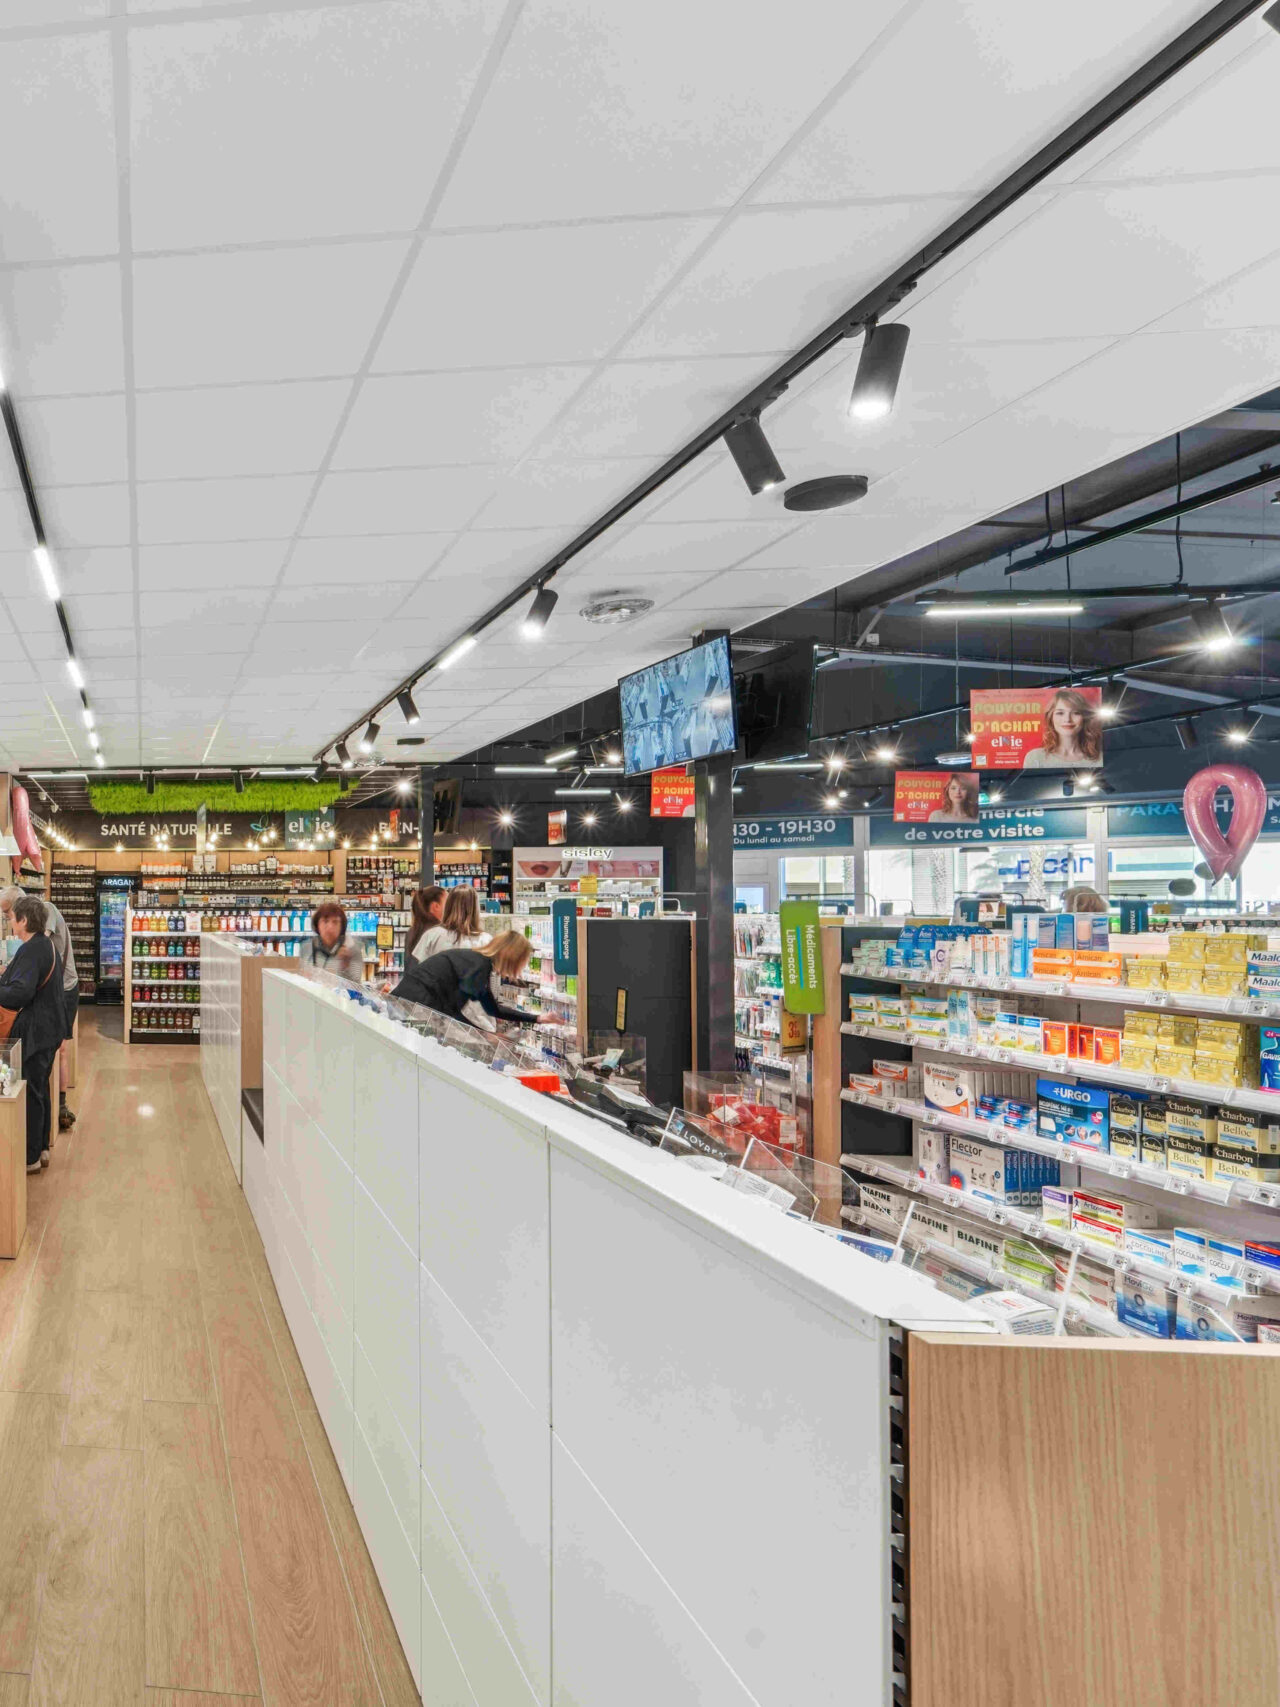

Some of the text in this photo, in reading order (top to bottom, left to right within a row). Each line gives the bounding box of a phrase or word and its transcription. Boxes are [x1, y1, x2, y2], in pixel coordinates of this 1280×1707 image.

[973, 702, 1042, 715] POUVOIR
[973, 720, 1041, 733] D'ACHAT
[896, 791, 942, 800] D'ACHAT
[101, 822, 232, 836] SANTÉ NATURLLE
[778, 819, 836, 834] 19H30
[905, 823, 1045, 841] de votre visite
[747, 836, 768, 844] lundi
[783, 834, 815, 843] samedi
[562, 848, 613, 860] sisley
[786, 929, 797, 985] Libre-accès
[805, 924, 818, 989] Médicaments
[1060, 1088, 1091, 1103] URGO
[1169, 1102, 1202, 1115] Charbon
[1171, 1115, 1200, 1127] Belloc
[1221, 1110, 1255, 1124] Charbon
[1223, 1124, 1252, 1137] Belloc
[951, 1138, 983, 1156] Flector
[1170, 1138, 1202, 1152] Charbon
[1173, 1153, 1200, 1166] Belloc
[1215, 1149, 1254, 1164] Charbon
[1218, 1162, 1250, 1177] Belloc
[862, 1185, 891, 1202] BIAFINE
[911, 1211, 948, 1233] BIAFINE
[957, 1230, 999, 1254] BIAFINE
[1131, 1241, 1169, 1260] COCCULINE
[1176, 1247, 1206, 1263] COCCULINE
